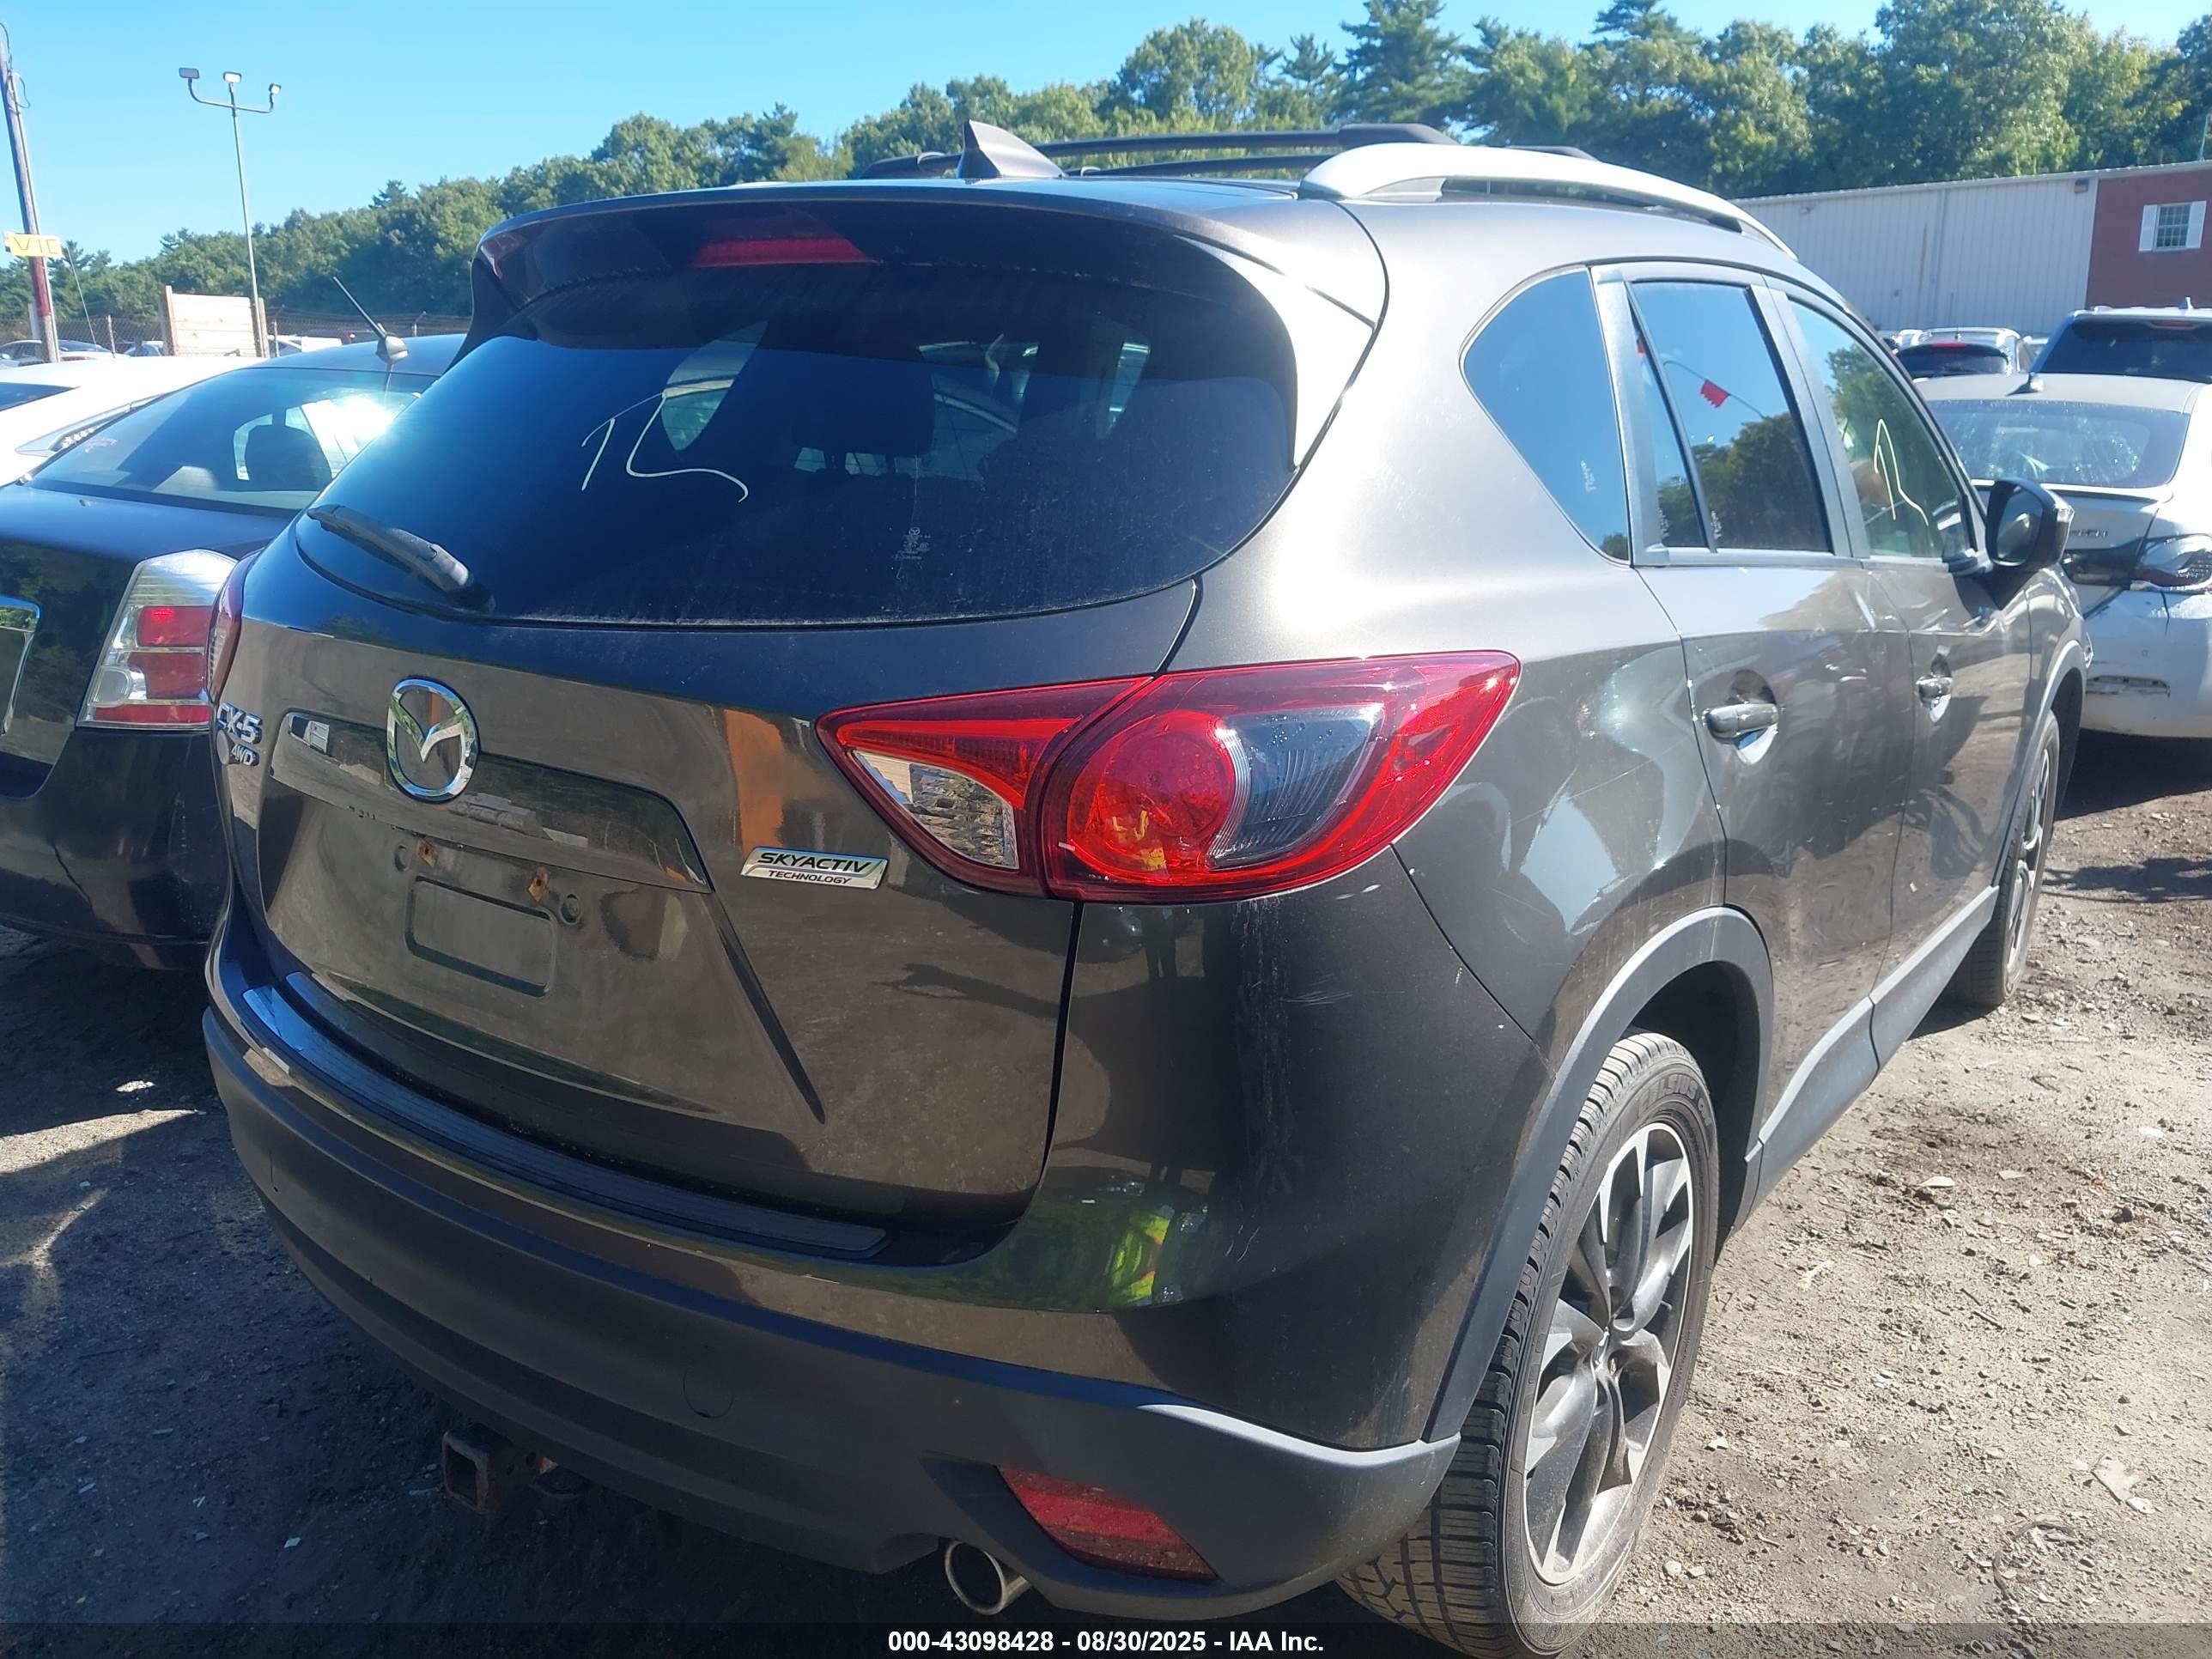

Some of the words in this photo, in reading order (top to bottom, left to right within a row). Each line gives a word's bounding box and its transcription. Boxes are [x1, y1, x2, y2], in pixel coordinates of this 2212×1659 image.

[231, 744, 258, 766] AWD
[757, 852, 872, 873] SKYACTIV
[768, 870, 853, 884] TECHNOLOGY
